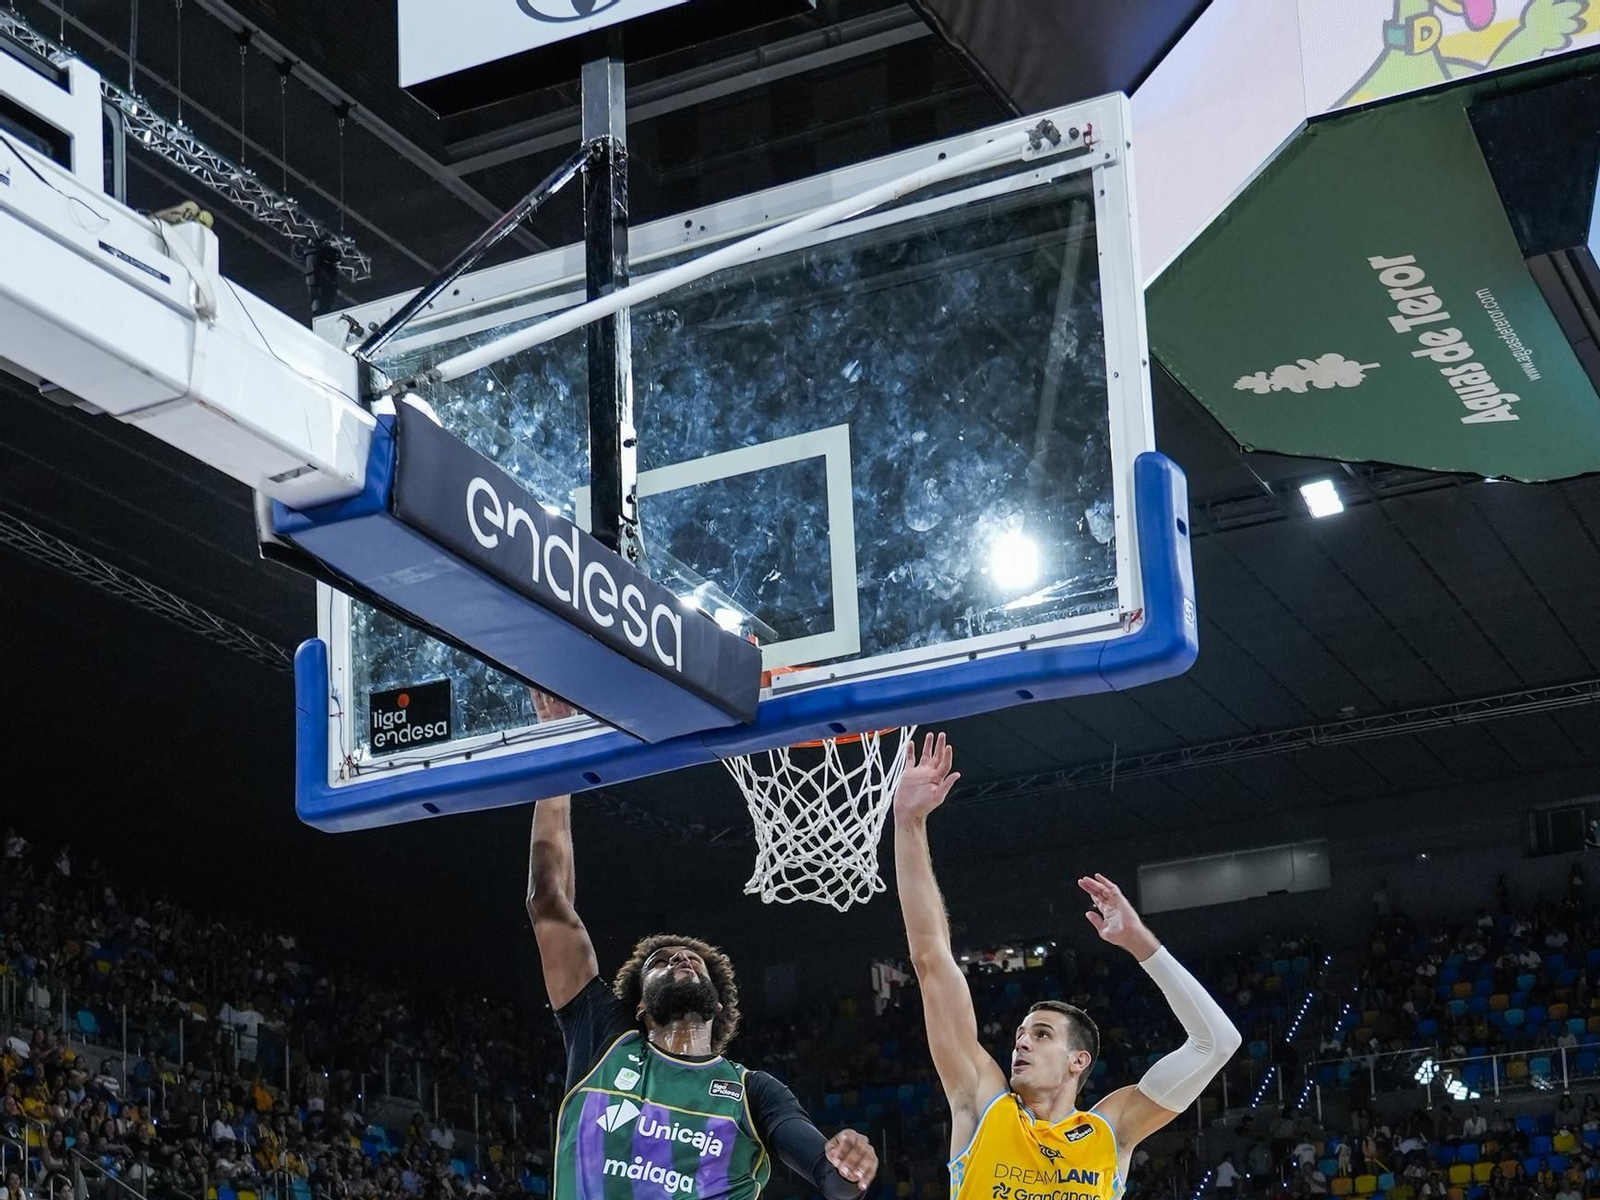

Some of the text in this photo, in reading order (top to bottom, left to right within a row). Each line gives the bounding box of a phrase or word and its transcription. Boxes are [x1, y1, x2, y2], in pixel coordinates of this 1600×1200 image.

[1367, 254, 1521, 424] Aguas de Teror
[1475, 288, 1542, 382] www.aguasdeteror.com
[466, 476, 683, 673] endesa
[373, 709, 406, 730] liga
[374, 721, 447, 748] endesa
[637, 1116, 724, 1157] Unicaja
